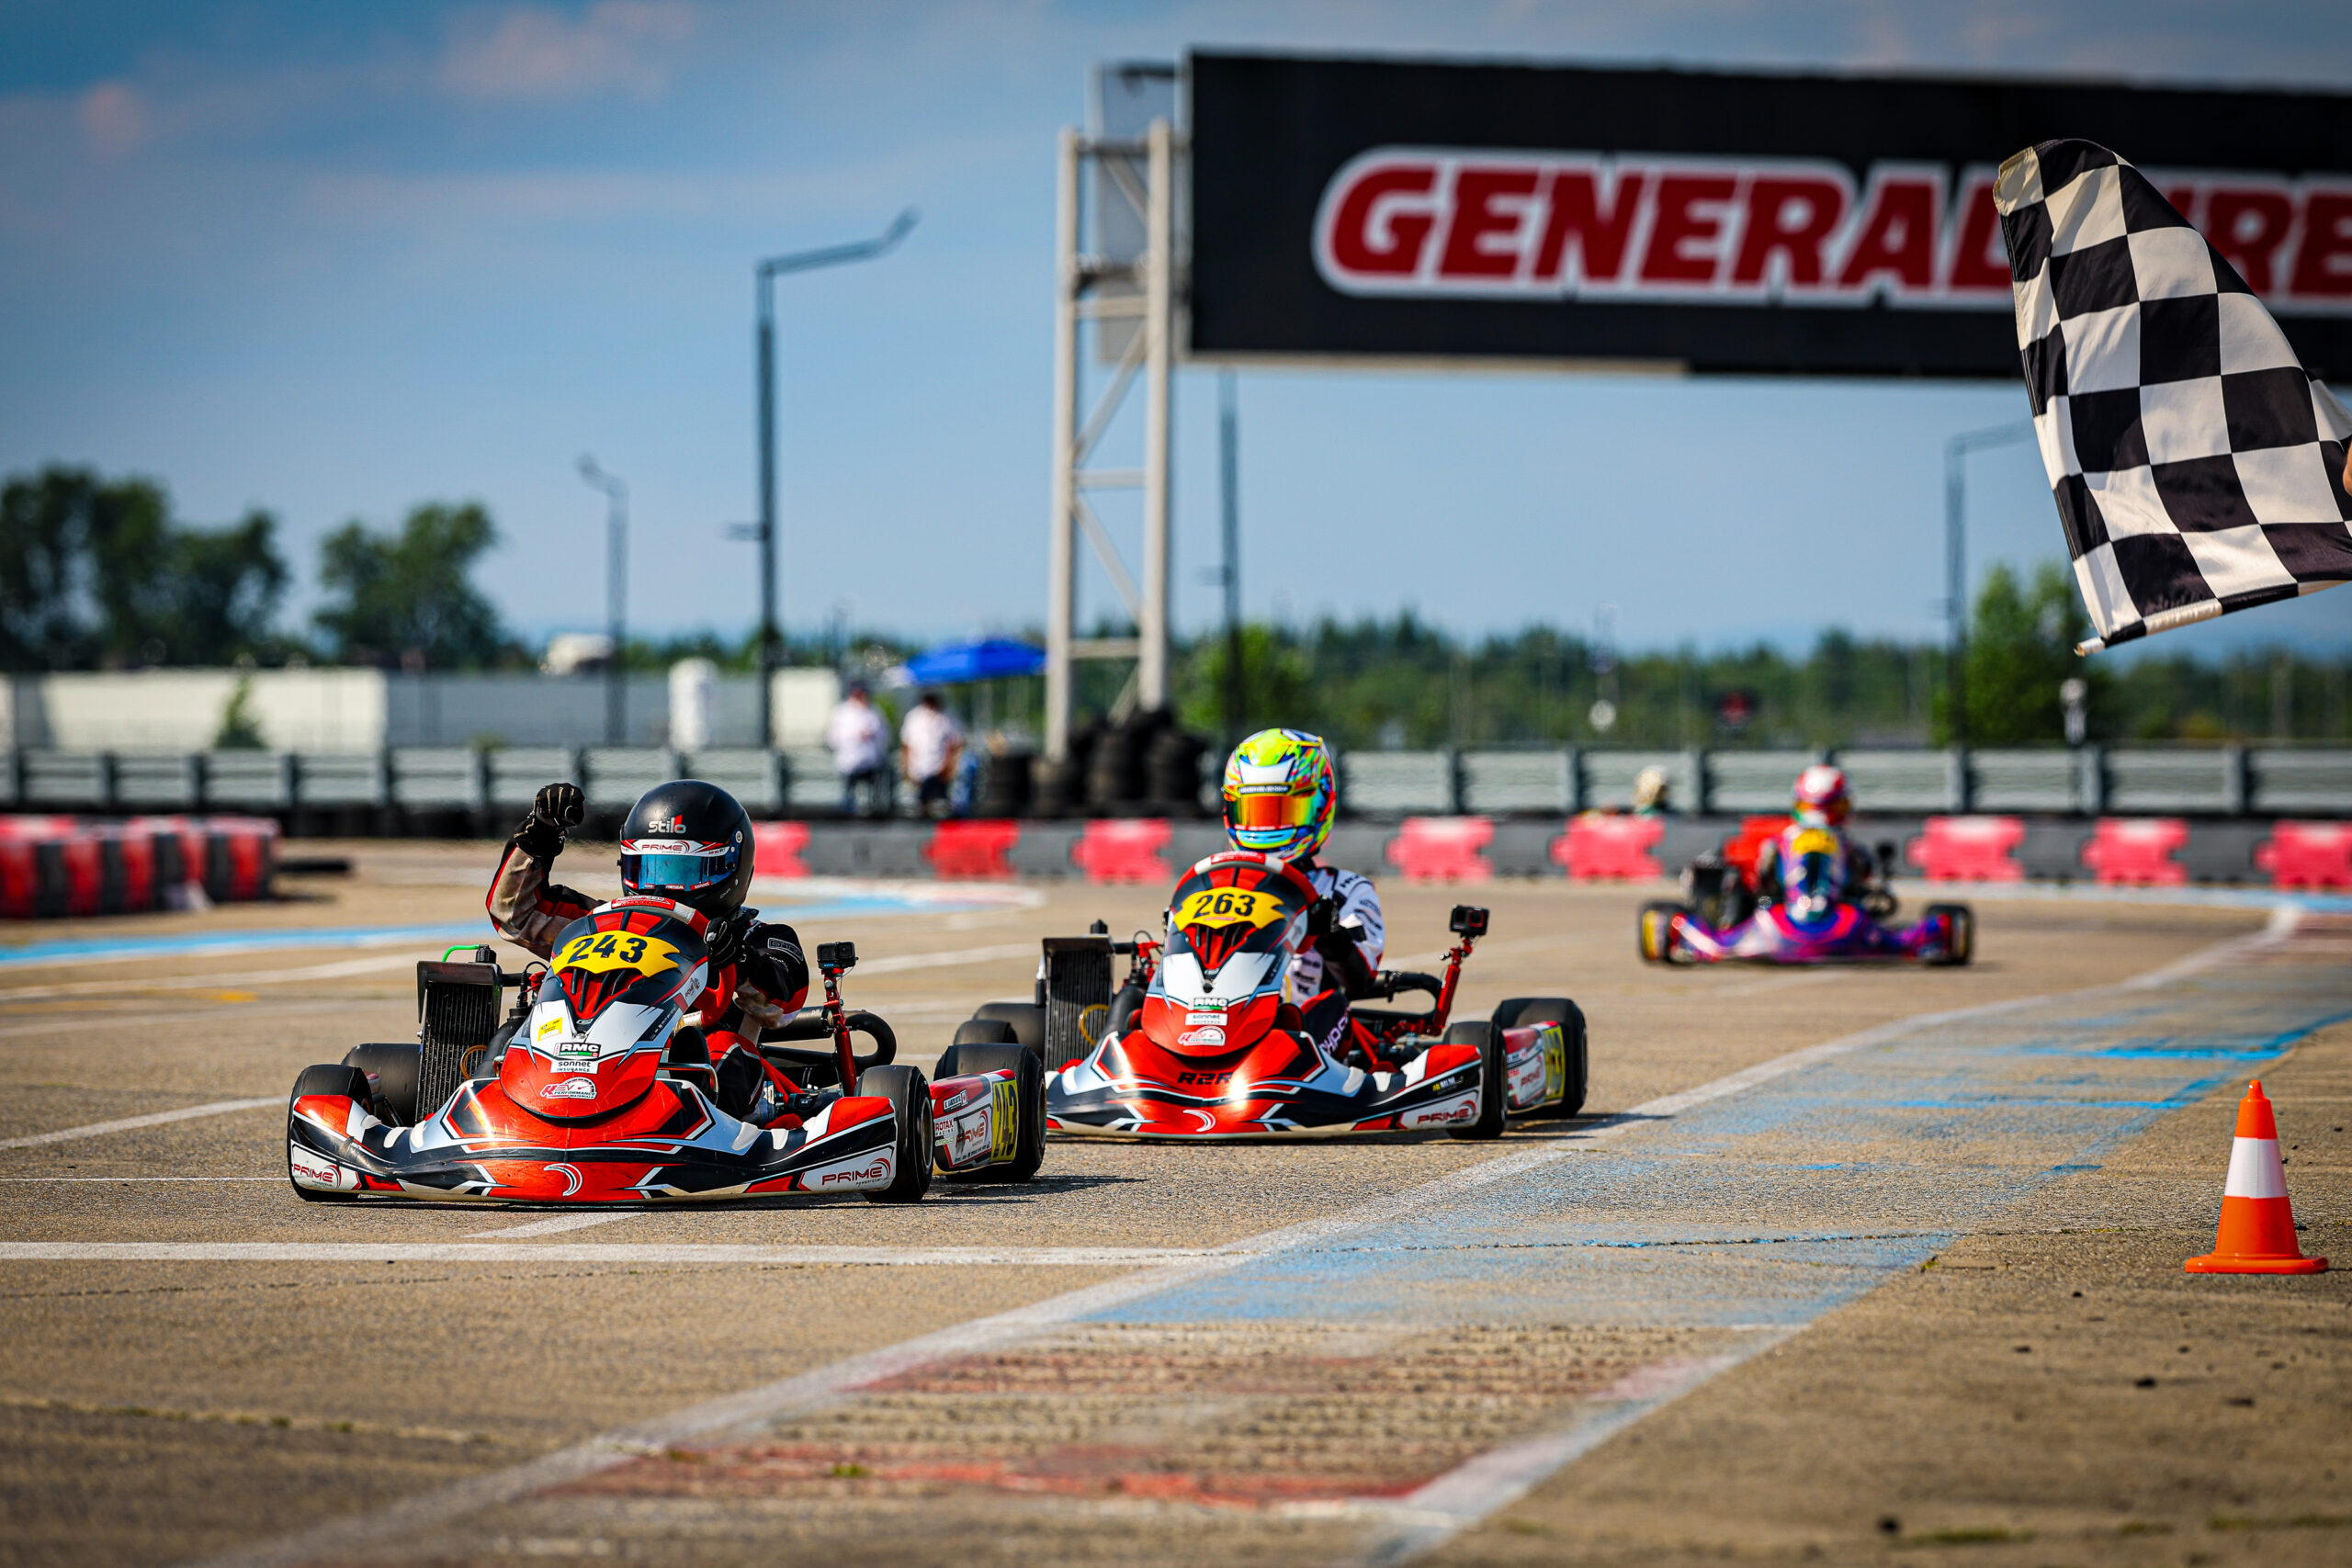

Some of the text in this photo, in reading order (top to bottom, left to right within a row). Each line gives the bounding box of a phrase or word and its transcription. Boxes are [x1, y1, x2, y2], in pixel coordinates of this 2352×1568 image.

[1327, 159, 2018, 292] GENERAL
[648, 815, 687, 834] stilo
[641, 843, 684, 852] PRIME
[1193, 893, 1257, 919] 263
[567, 934, 648, 964] 243
[560, 1043, 600, 1053] RMC
[1177, 1072, 1233, 1085] R2R
[935, 1119, 954, 1132] ROTAX
[992, 1082, 1018, 1158] 243
[1417, 1108, 1470, 1125] PRIME
[293, 1163, 334, 1183] PRIME
[821, 1166, 883, 1186] PRIME
